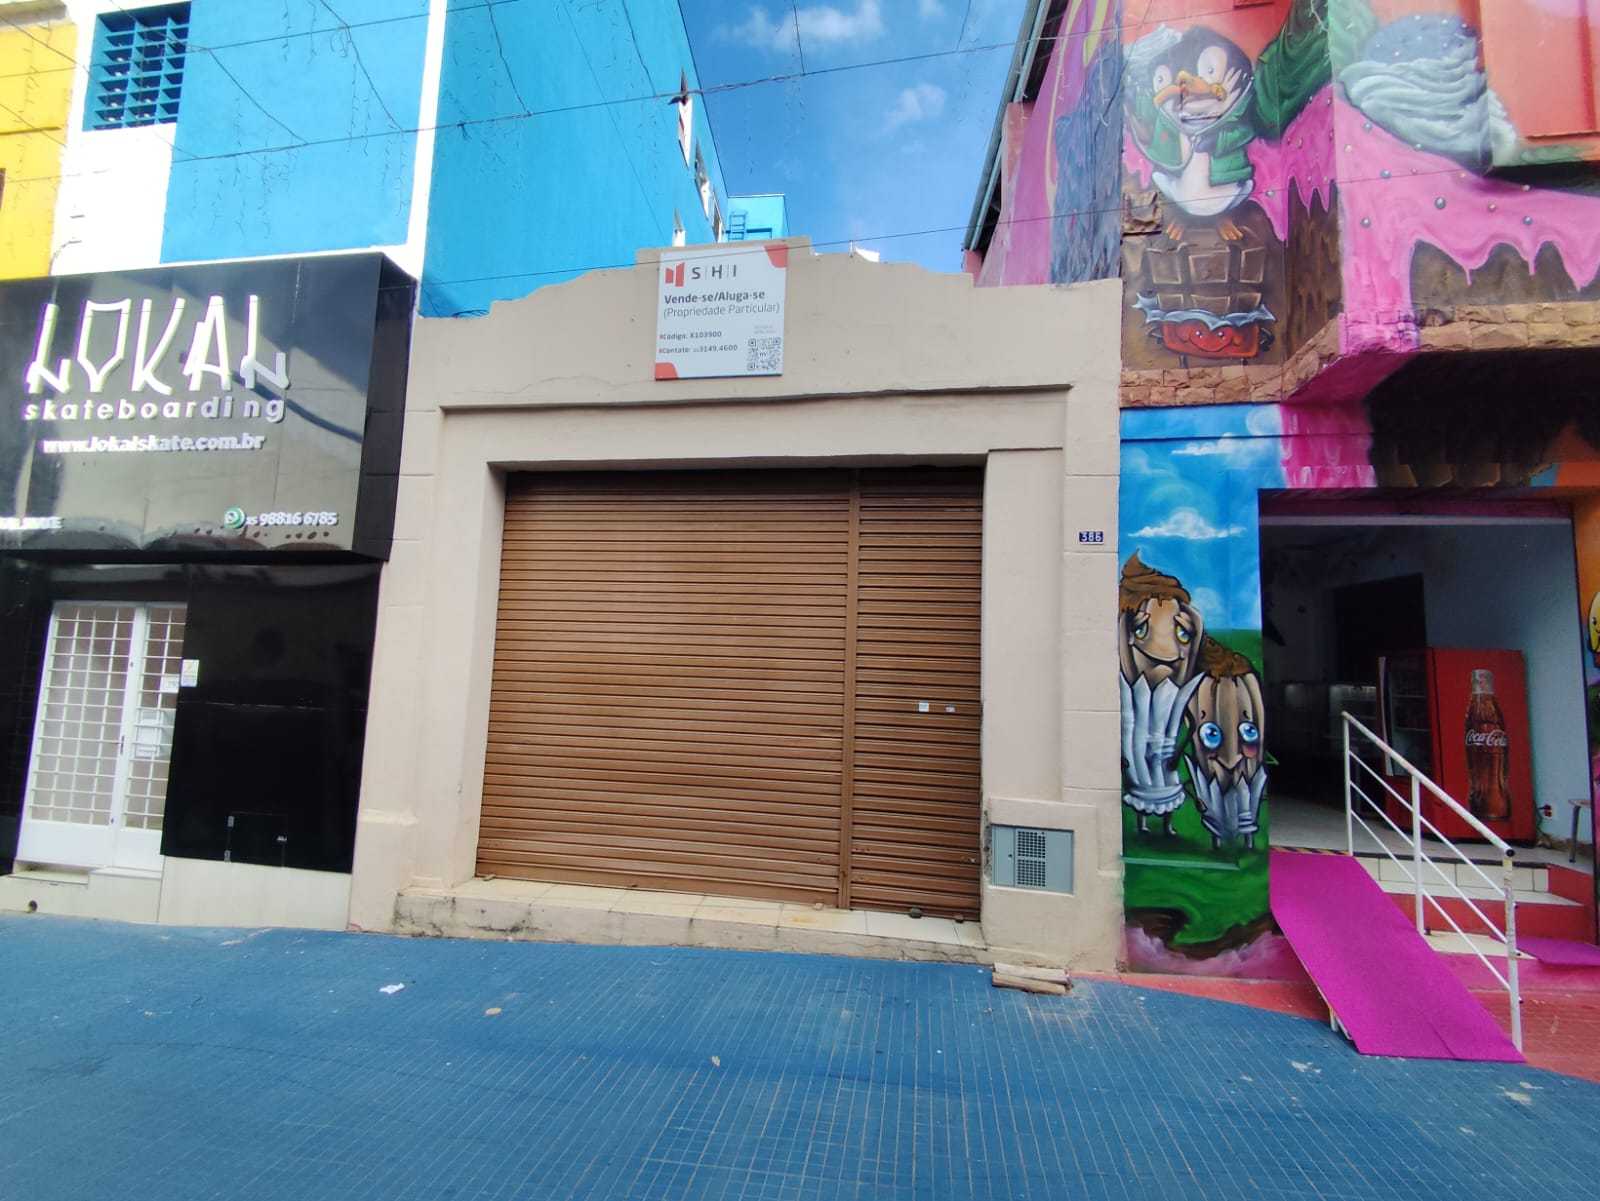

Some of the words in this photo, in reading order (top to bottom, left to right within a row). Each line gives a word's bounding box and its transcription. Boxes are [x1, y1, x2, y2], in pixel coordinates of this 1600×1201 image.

[664, 291, 766, 304] Vende-se/Aluga-se
[663, 306, 726, 319] (Propriedade
[728, 303, 780, 314] Particular)
[26, 294, 291, 395] LOKAL
[23, 396, 286, 424] skateboarding
[43, 433, 266, 454] www.lokalskate.com.br
[304, 511, 338, 526] 6785
[1465, 729, 1507, 746] Coca-Cola
